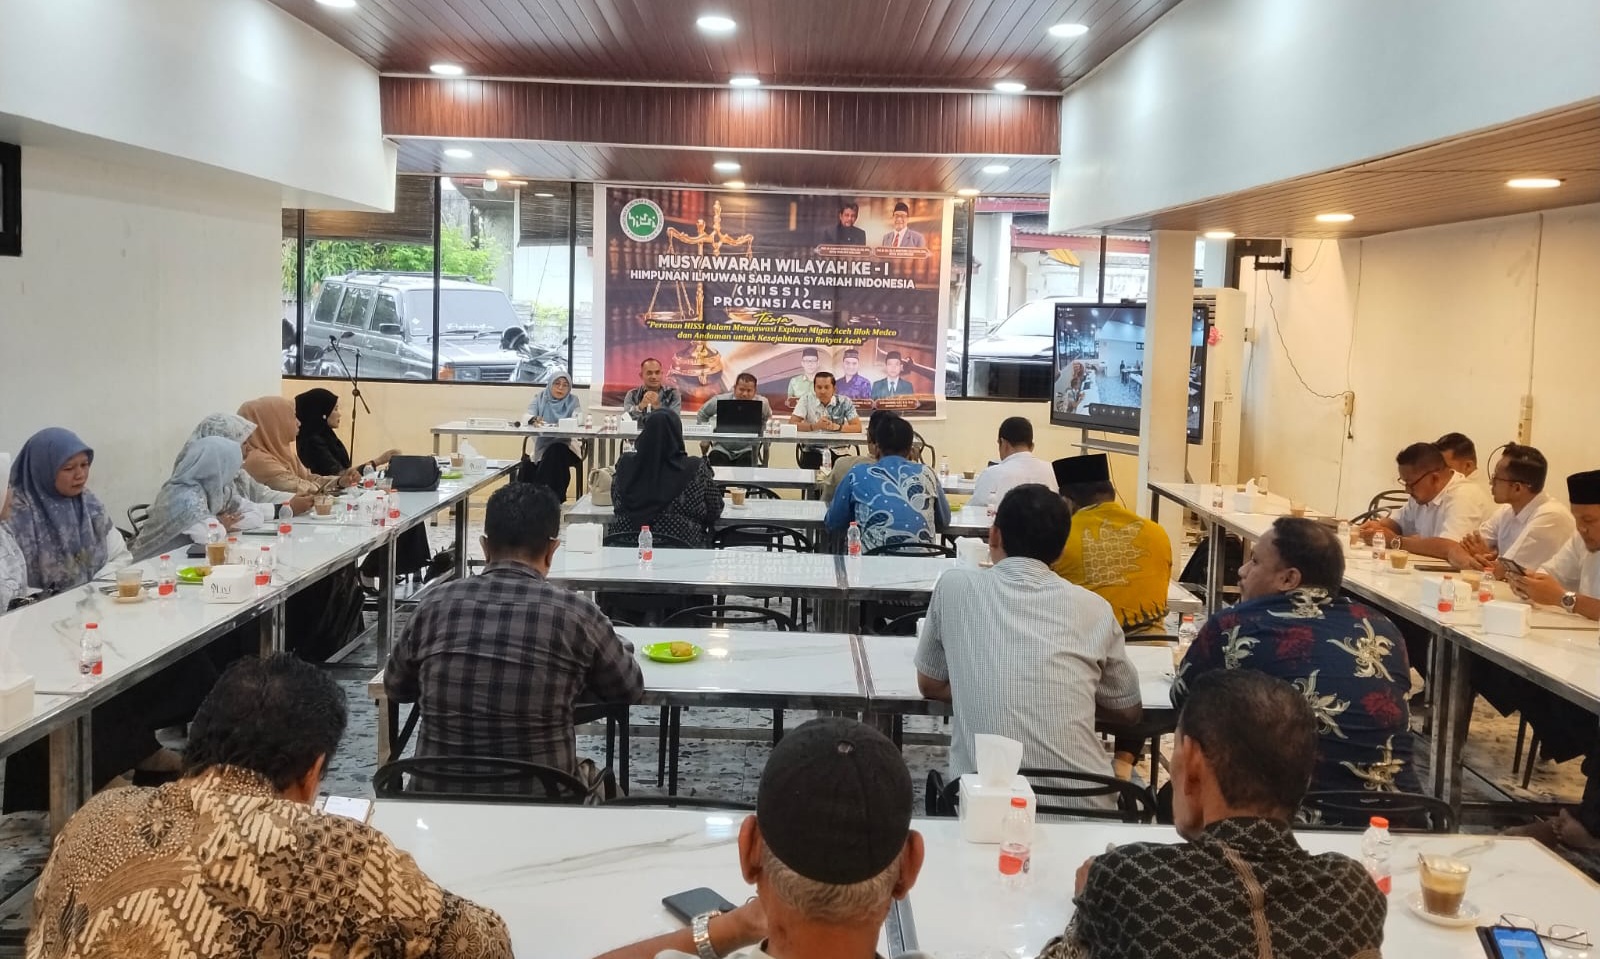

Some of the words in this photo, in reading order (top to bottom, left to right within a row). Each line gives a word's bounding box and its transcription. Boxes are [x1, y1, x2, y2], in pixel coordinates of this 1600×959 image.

[658, 254, 771, 272] MUSYAWARAH
[775, 258, 848, 275] WILAYAH
[851, 261, 871, 276] KE
[630, 270, 690, 281] HIMPUNAN
[691, 271, 746, 283] ILMUWAN
[748, 273, 801, 285] SARJANA
[803, 275, 851, 287] SYARIAH
[854, 277, 915, 289] INDONESIA
[713, 296, 787, 309] PROVINSI
[790, 299, 832, 310] ACEH
[684, 322, 705, 330] HISSI
[706, 323, 731, 331] dalam
[733, 324, 777, 333] Mengawasi
[778, 325, 808, 334] Explore
[808, 326, 832, 336] Migas
[833, 327, 852, 335] Aceh
[853, 328, 871, 336] Blok
[872, 328, 897, 337] Medco
[677, 331, 693, 339] dan
[757, 335, 814, 344] Kesejahteraan
